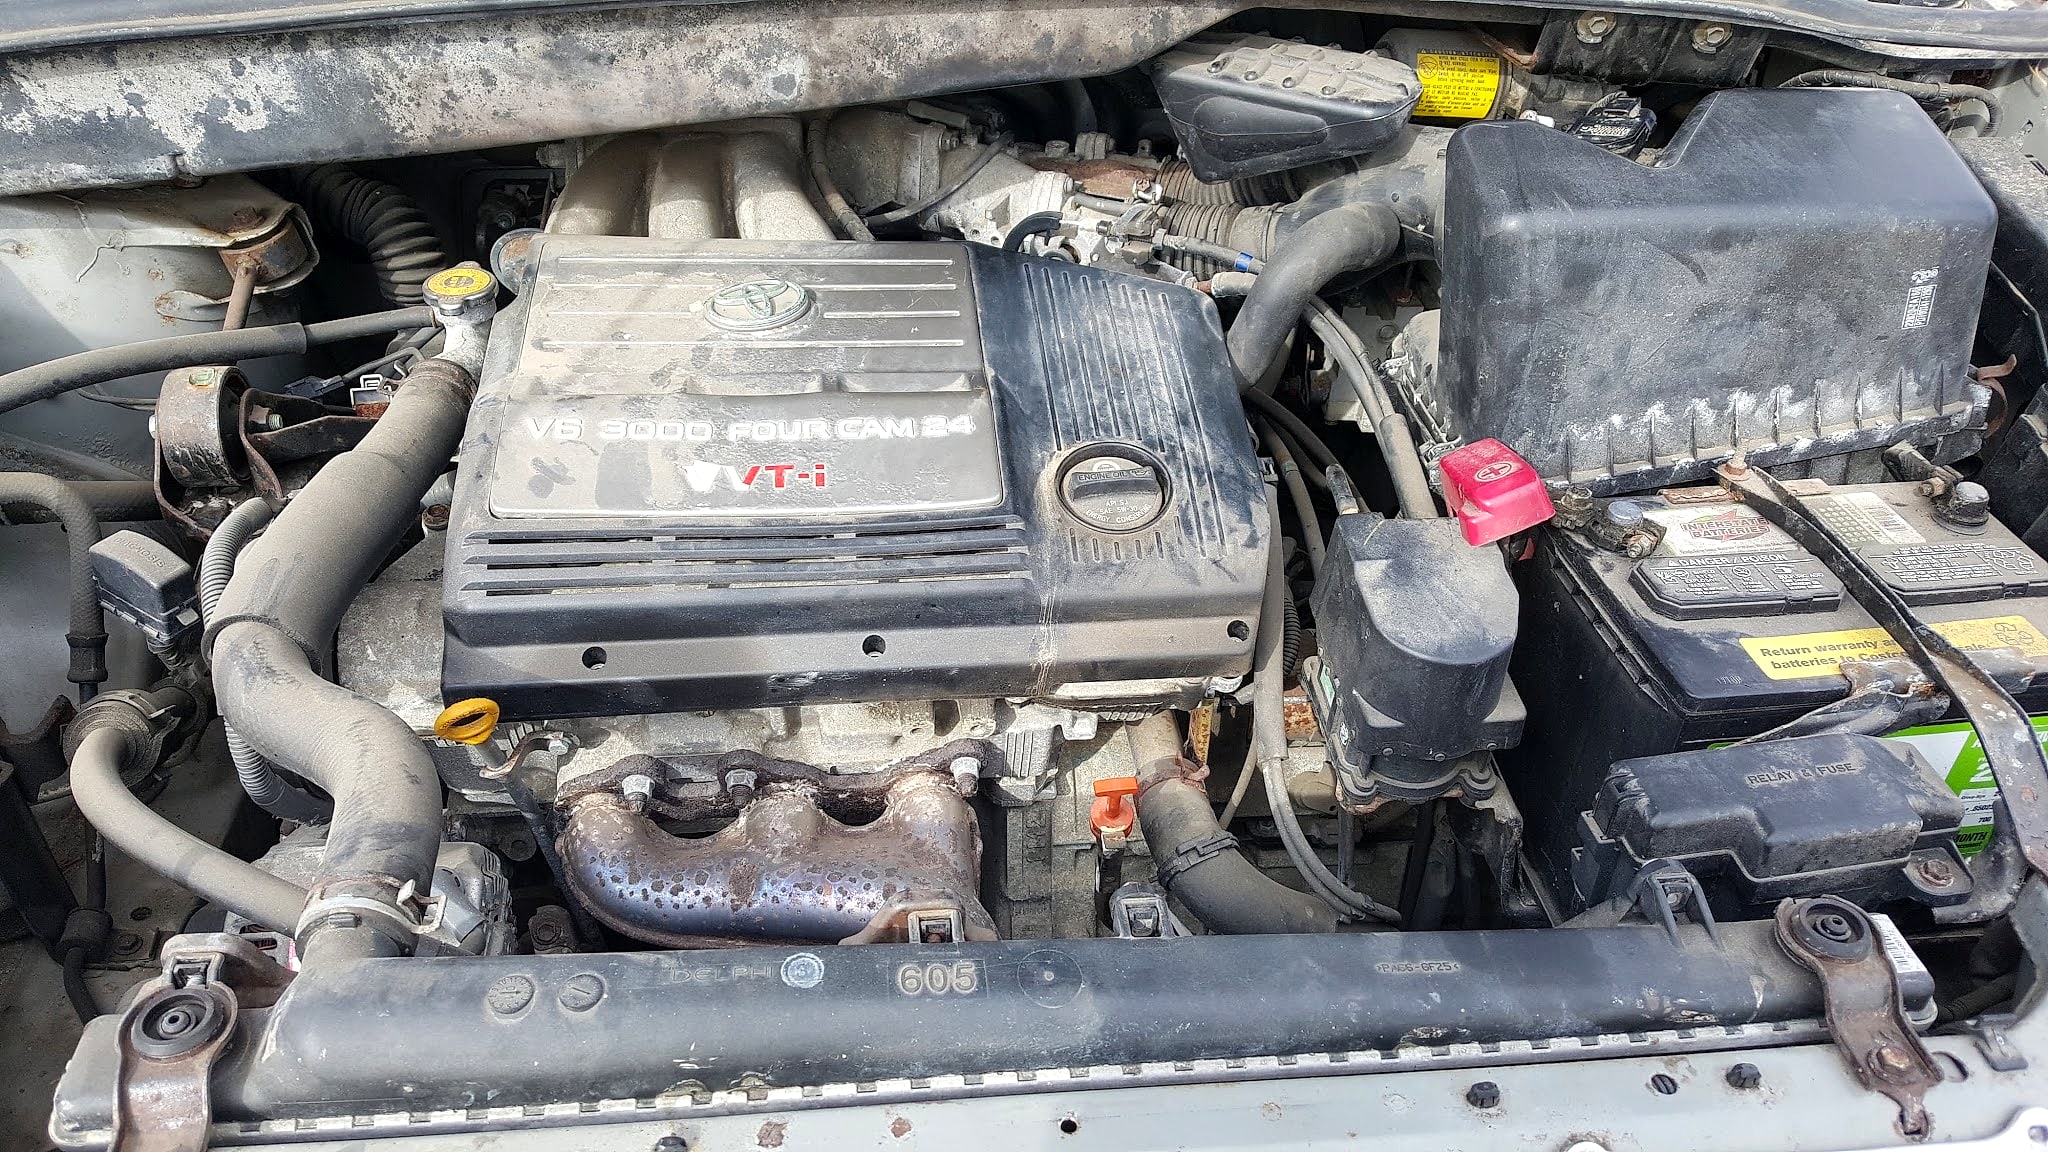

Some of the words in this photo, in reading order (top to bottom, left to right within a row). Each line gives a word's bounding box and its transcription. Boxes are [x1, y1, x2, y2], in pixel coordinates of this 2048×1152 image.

[526, 417, 583, 441] V6
[600, 419, 713, 442] 3000
[728, 418, 831, 441] FOUR
[836, 415, 916, 439] CAM
[922, 414, 976, 437] 24
[1112, 471, 1128, 479] OIL
[1086, 509, 1111, 522] ENERGY
[1682, 517, 1769, 531] INTERSTATE
[1692, 526, 1769, 538] BATTERIES
[1678, 557, 1731, 567] DANGER
[1740, 553, 1789, 564] POISON
[1760, 645, 1811, 657] Return
[1814, 640, 1878, 653] warranty
[1771, 656, 1838, 670] batteries
[1747, 770, 1795, 784] RELAY
[1816, 763, 1857, 775] FUSE
[899, 962, 977, 994] 605
